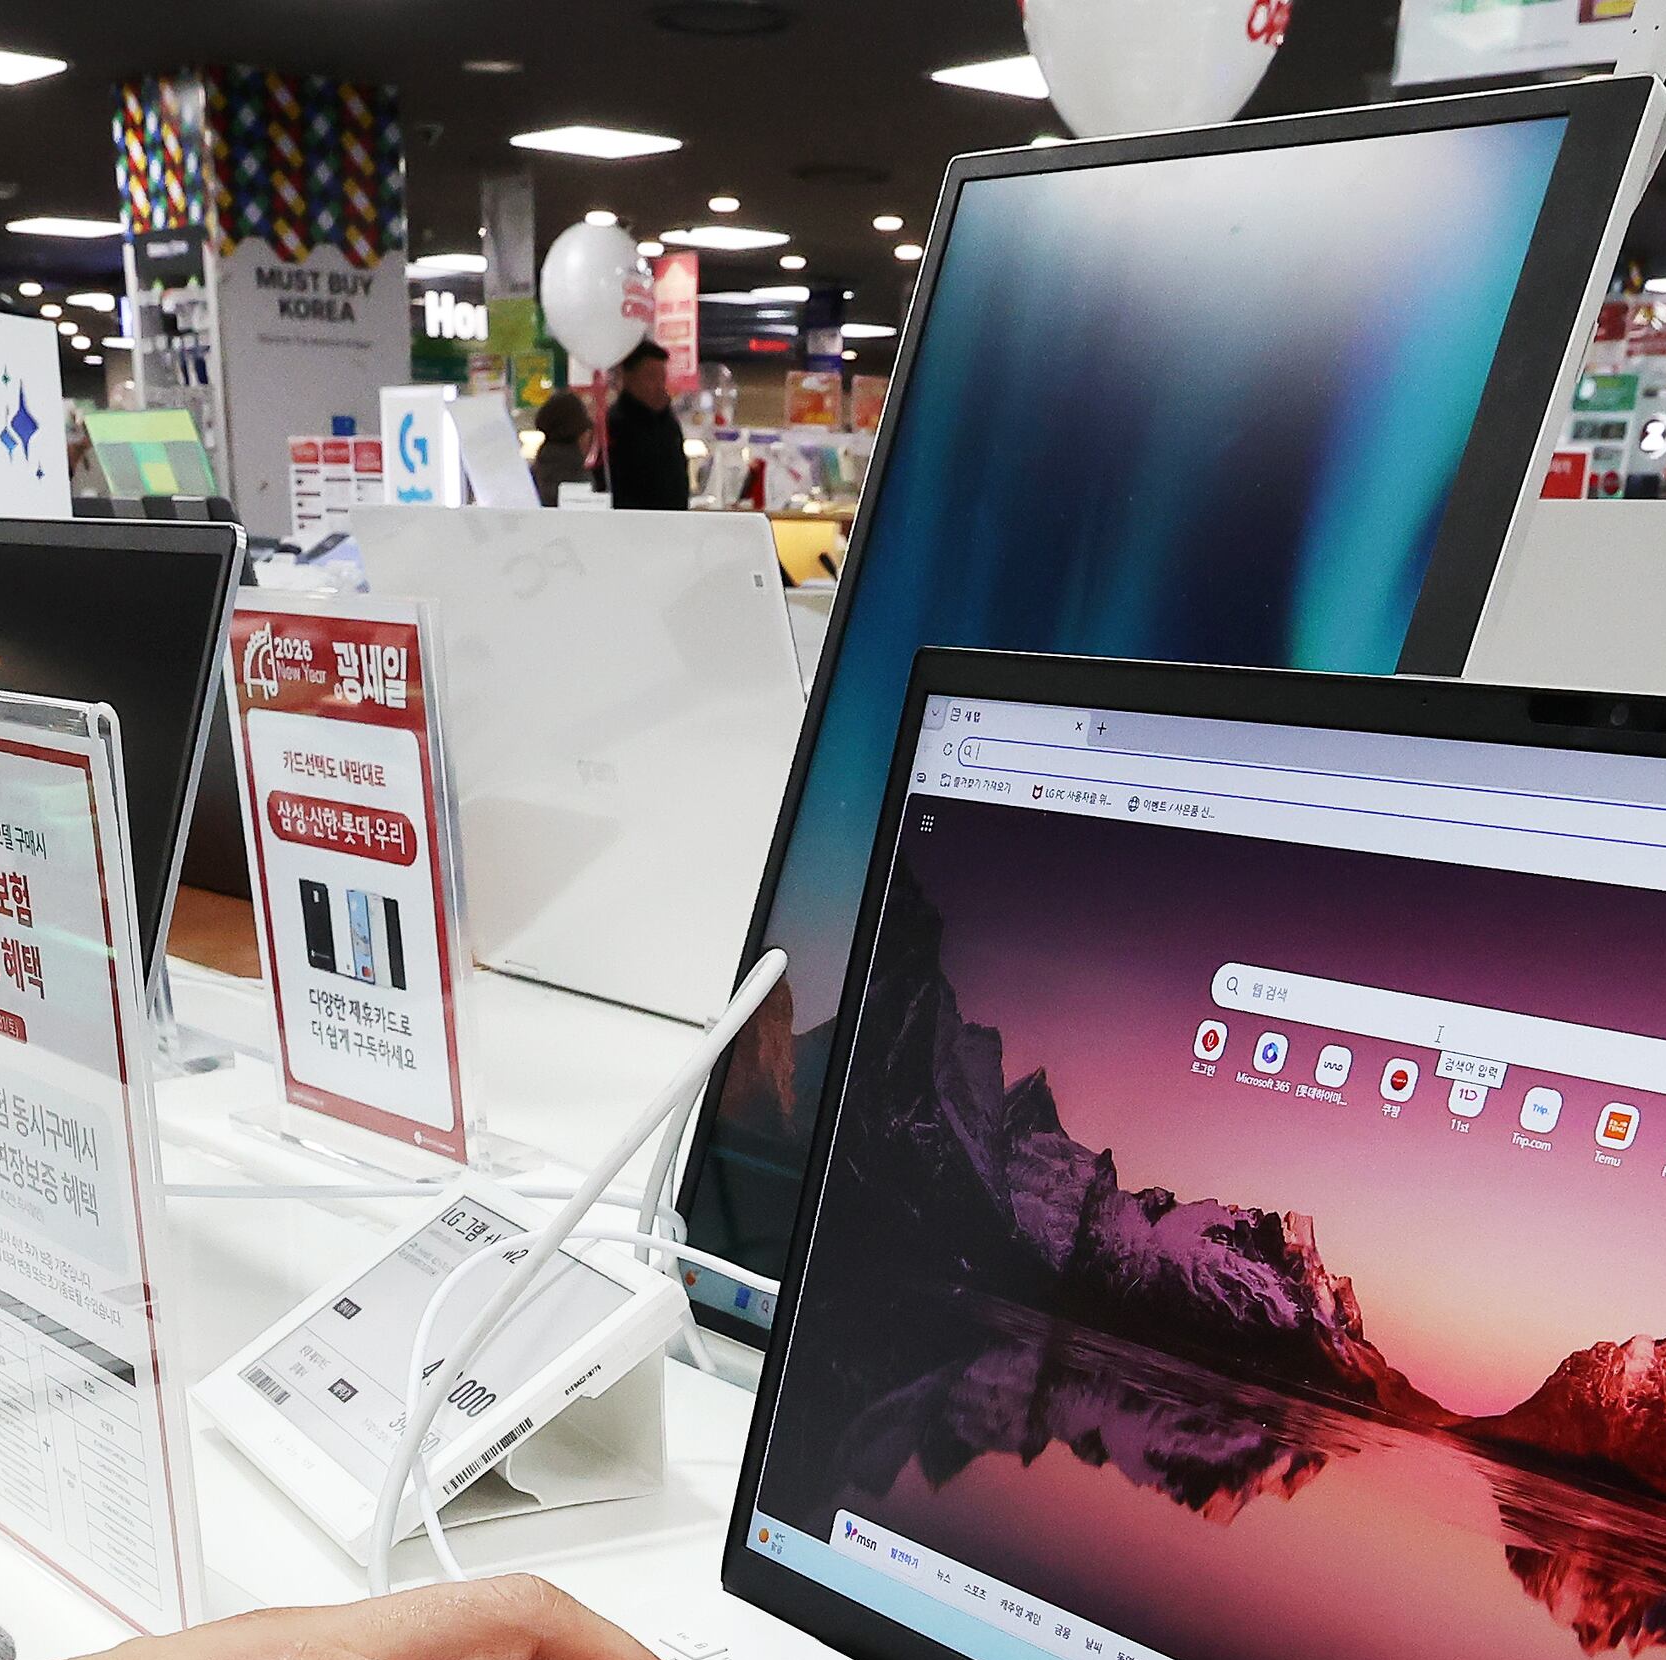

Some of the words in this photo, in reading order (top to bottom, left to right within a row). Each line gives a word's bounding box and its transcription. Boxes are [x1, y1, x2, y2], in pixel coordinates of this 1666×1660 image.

[255, 266, 322, 292] MUST
[328, 271, 375, 297] BUY
[278, 299, 356, 324] KOREA
[274, 636, 313, 662] 2026
[303, 663, 327, 685] Year
[332, 640, 408, 709] 광세일
[283, 750, 337, 779] 카드선택도
[339, 760, 386, 787] 내맘대로
[1, 936, 45, 1000] 혜택
[1251, 983, 1264, 999] 웹
[1265, 985, 1289, 1003] 검색
[309, 988, 346, 1022] 다양한
[349, 1000, 413, 1036] 제휴카드로
[311, 1020, 324, 1046] 더
[325, 1026, 351, 1054] 쉽게
[353, 1032, 417, 1070] 구독하세요
[1190, 1061, 1217, 1077] 로그인
[1444, 1056, 1476, 1075] 검색어
[1478, 1062, 1500, 1080] 입력
[1235, 1071, 1273, 1090] Microsoft
[1274, 1080, 1292, 1093] 365
[1380, 1104, 1401, 1119] 쿠팡
[12, 1094, 99, 1171] 동시구매시
[1450, 1119, 1470, 1134] 11st
[1511, 1131, 1552, 1153] Trip.com
[1594, 1150, 1621, 1168] Temu
[62, 1171, 100, 1227] 혜택
[440, 1206, 461, 1227] LG
[856, 1531, 878, 1552] msn
[936, 1568, 952, 1585] 뉴스
[963, 1583, 988, 1601] 스포츠
[1000, 1598, 1024, 1618] 캐주얼
[1054, 1622, 1072, 1640] 금융
[1085, 1636, 1103, 1655] 날씨
